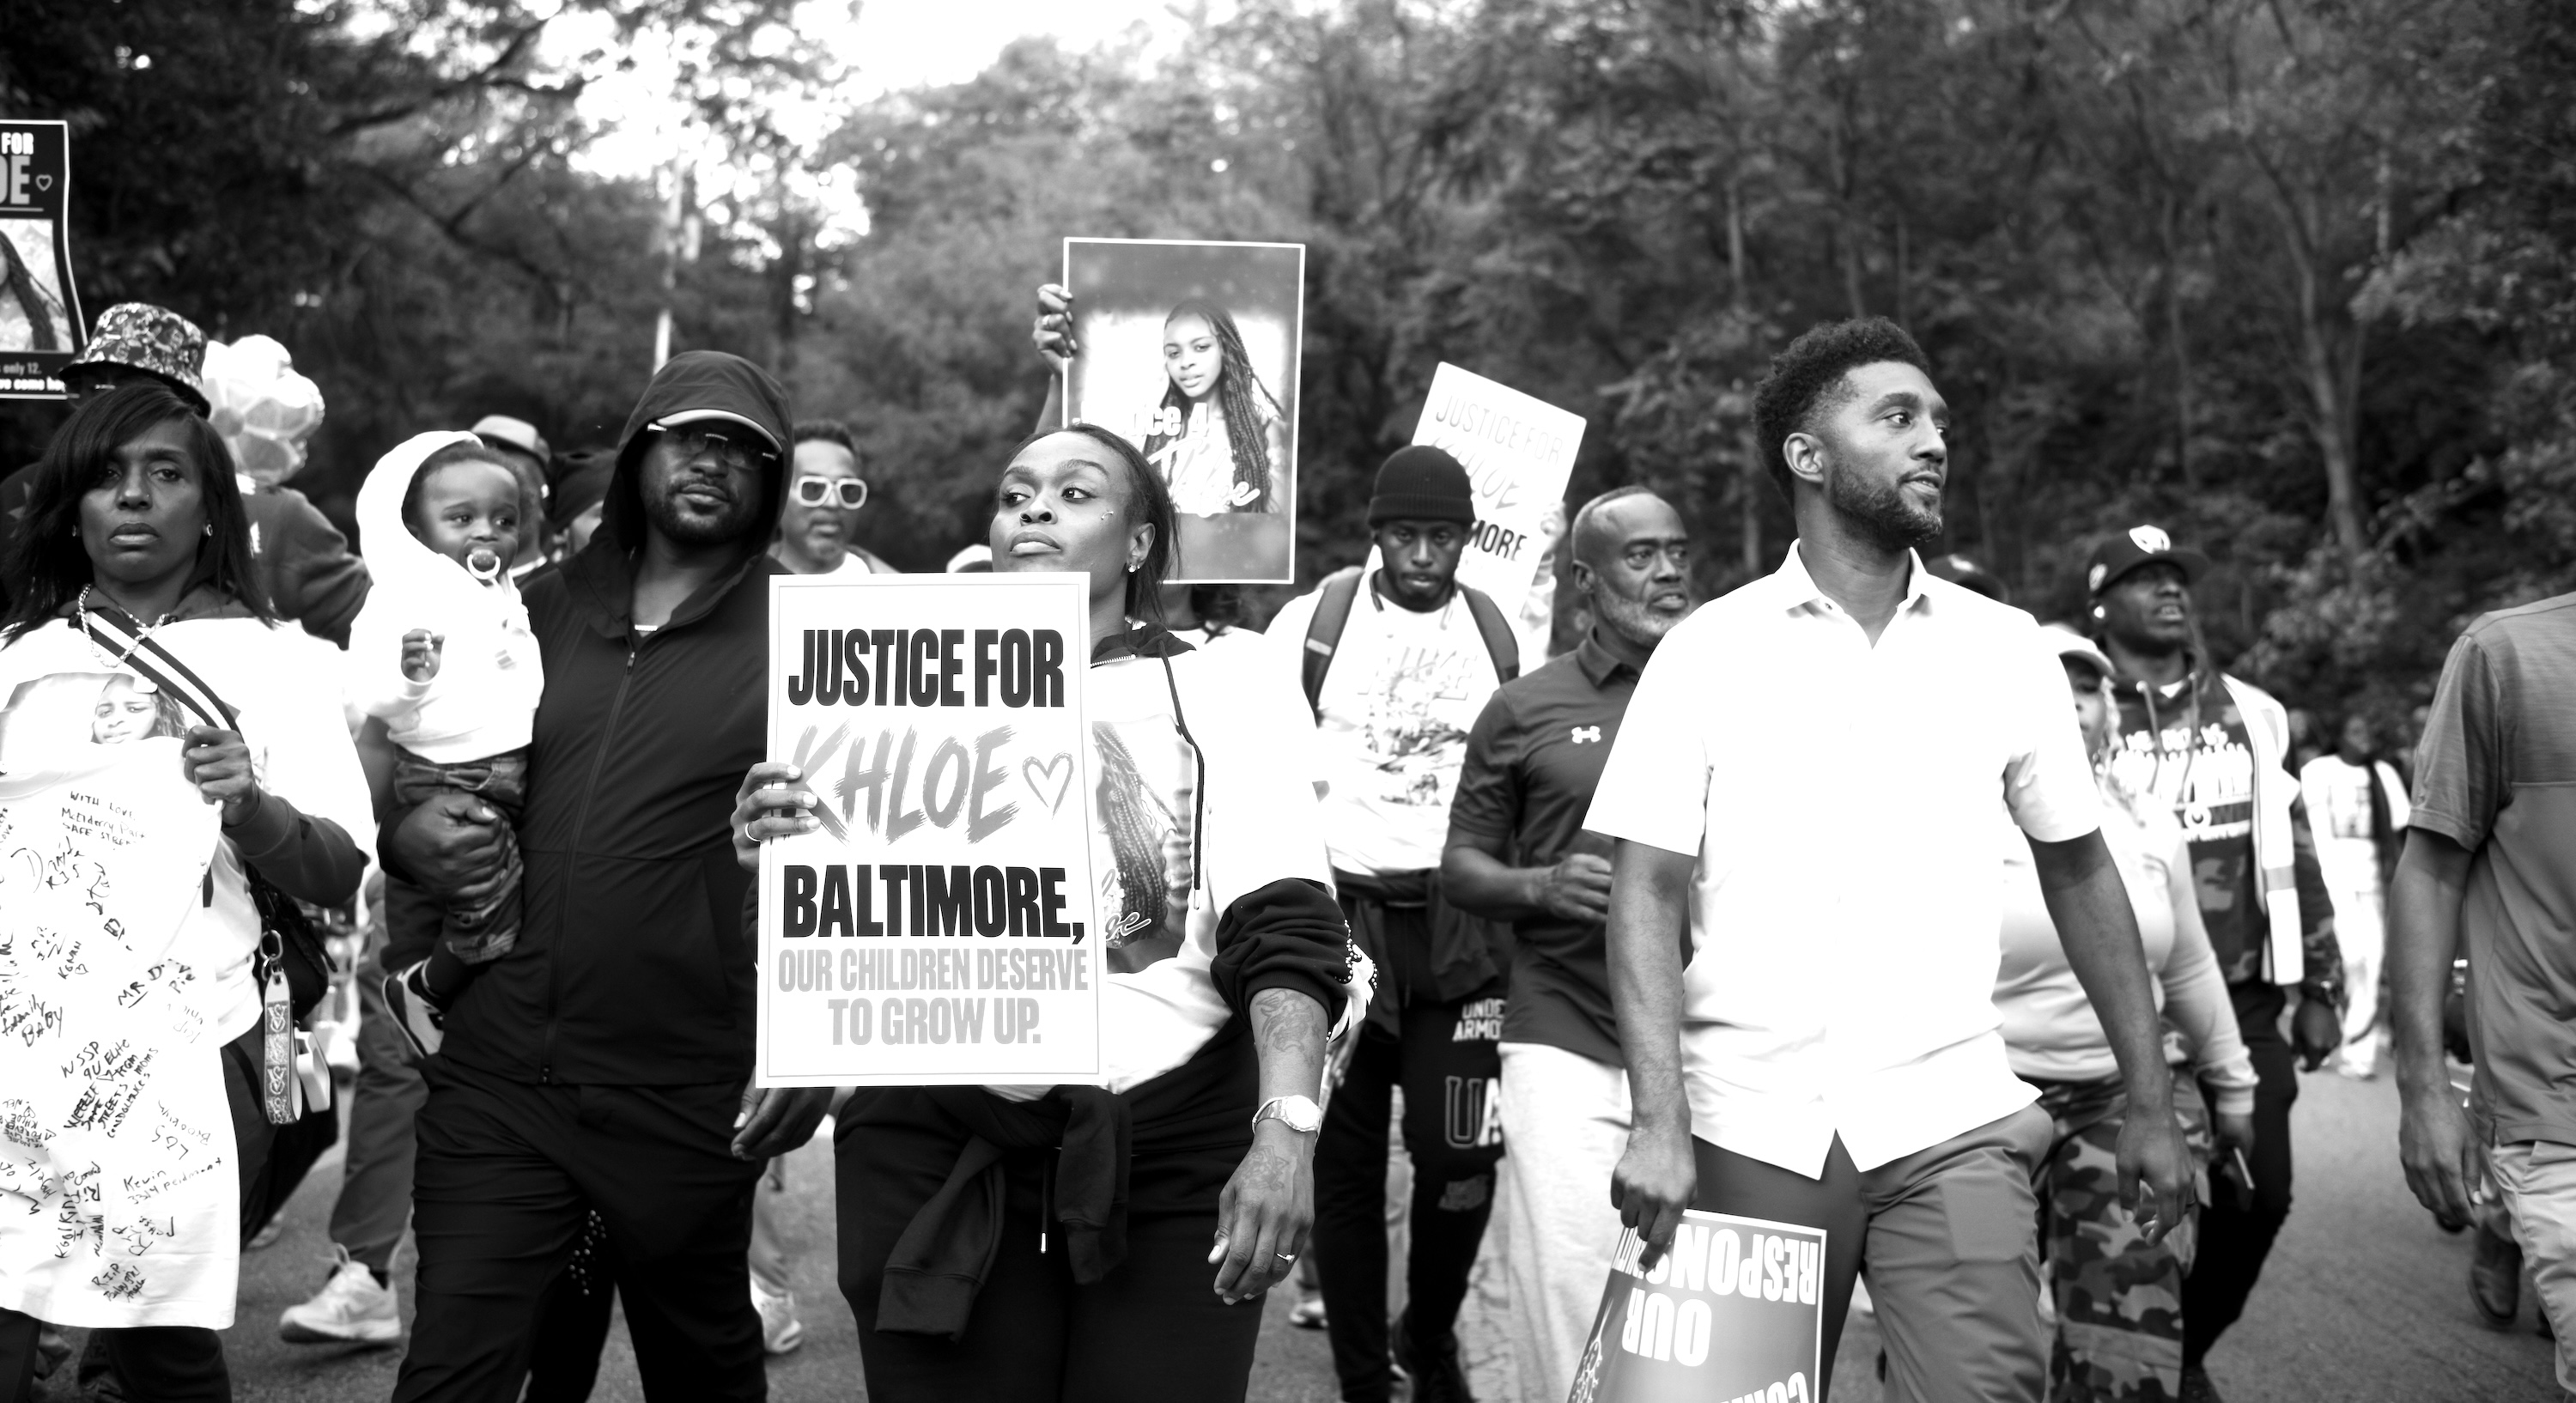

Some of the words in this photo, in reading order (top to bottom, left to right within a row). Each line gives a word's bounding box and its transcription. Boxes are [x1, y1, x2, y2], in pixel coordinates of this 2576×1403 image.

[2, 132, 34, 155] FOR
[1436, 395, 1522, 449] JUSTICE
[1523, 427, 1564, 466] FOR
[788, 629, 965, 707] JUSTICE
[975, 629, 1065, 708] FOR
[782, 719, 1020, 846] KHLOE
[783, 865, 1084, 945] BALTIMORE,
[779, 948, 834, 992] OUR
[840, 948, 970, 991] CHILDREN
[977, 948, 1089, 992] DESERVE
[828, 998, 872, 1045] TO
[881, 997, 987, 1045] GROW
[993, 997, 1042, 1044] UP.
[1451, 1018, 1503, 1042] ARMO
[1461, 998, 1507, 1020] UNDE
[123, 1169, 167, 1193] Kevin
[1621, 1287, 1712, 1367] OUR
